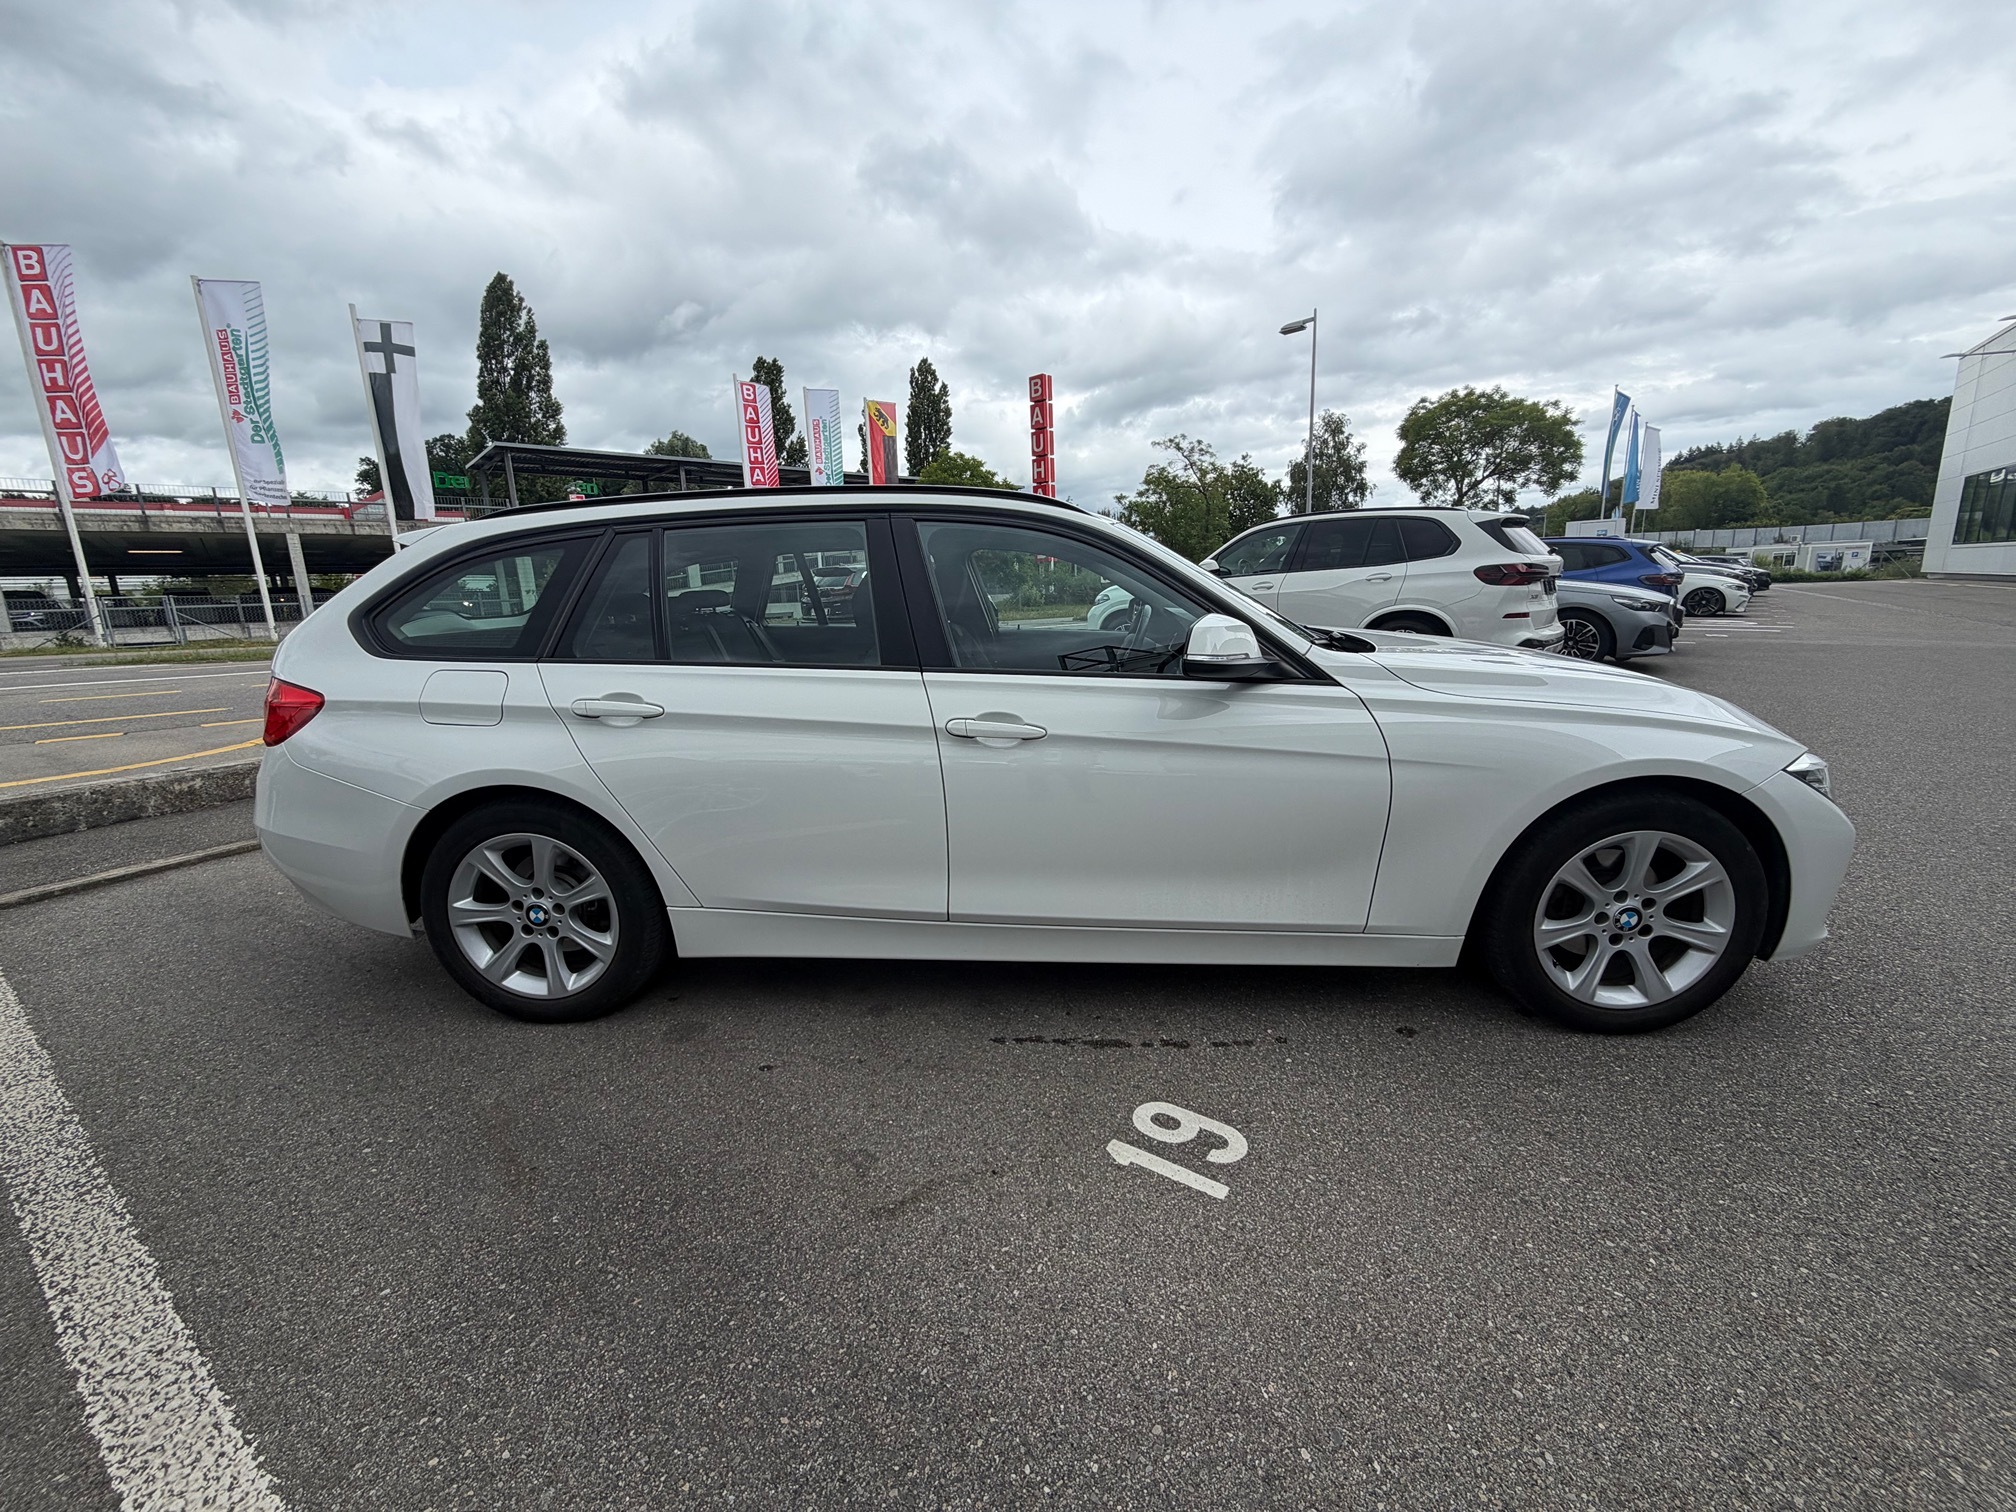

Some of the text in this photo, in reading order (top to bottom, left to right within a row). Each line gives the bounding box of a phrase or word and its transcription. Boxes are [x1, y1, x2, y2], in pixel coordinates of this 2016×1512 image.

[15, 250, 95, 494] BAUHAUS
[217, 329, 241, 405] BAUHAUS
[230, 329, 266, 444] Der Stadtgarten
[742, 384, 765, 483] BAUHA
[812, 418, 824, 465] BAUHAUS
[1030, 378, 1045, 495] BAUH
[1106, 1102, 1248, 1200] 19
